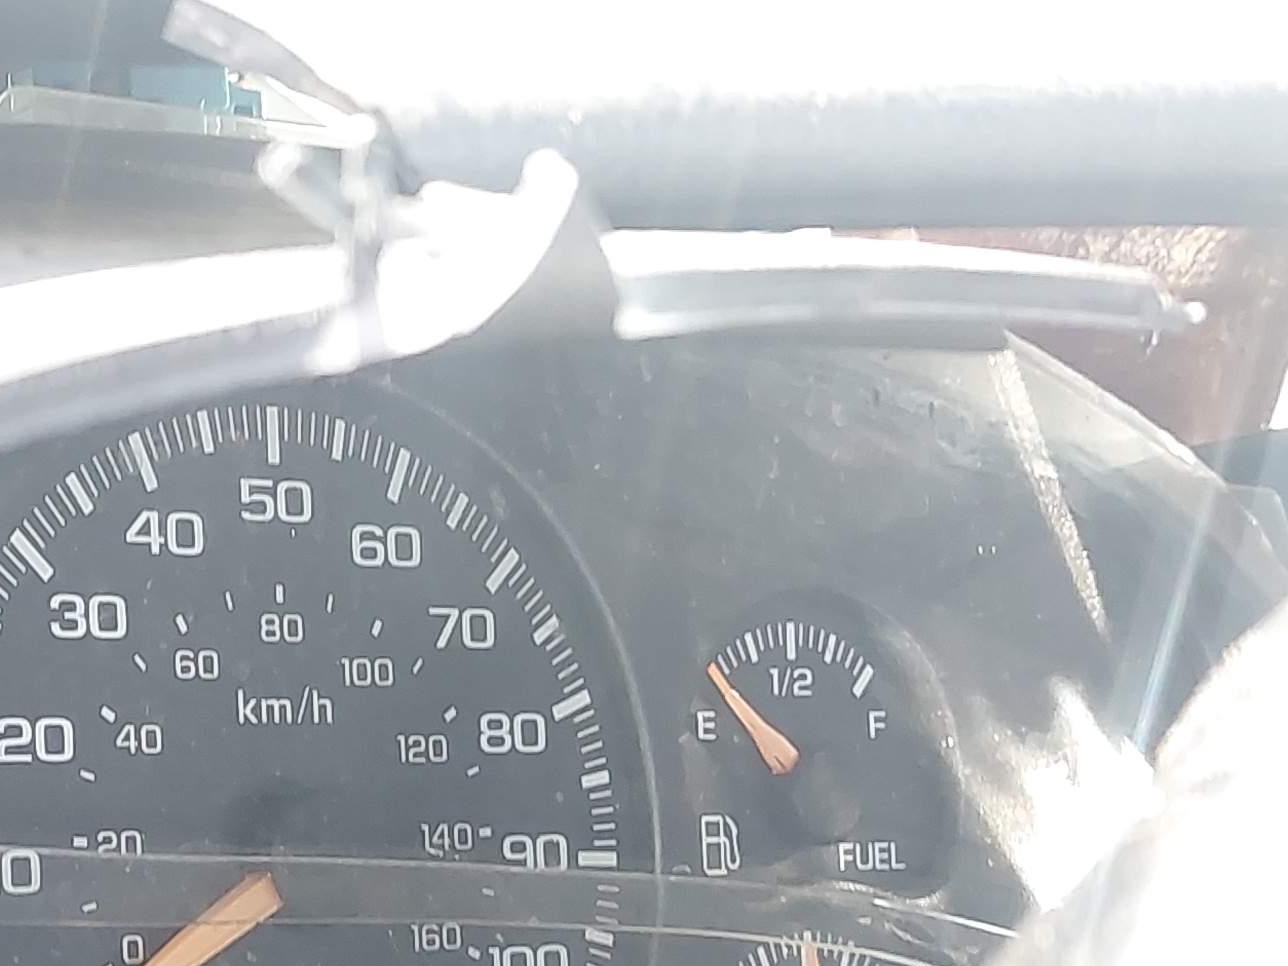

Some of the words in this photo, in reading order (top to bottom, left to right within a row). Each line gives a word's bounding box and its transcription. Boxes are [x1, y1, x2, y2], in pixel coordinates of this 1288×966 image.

[240, 479, 312, 522] 50
[126, 511, 204, 555] 40
[352, 525, 422, 567] 60
[49, 594, 128, 639] 30
[260, 614, 304, 642] 80
[428, 607, 495, 649] 70
[174, 650, 220, 680] 60
[341, 656, 394, 687] 100
[769, 666, 813, 697] 1/2
[236, 685, 334, 725] km/h
[115, 724, 163, 754] 40
[479, 713, 547, 754] 80
[697, 711, 717, 741] E
[867, 711, 887, 739] F
[397, 734, 448, 763] 120
[97, 831, 143, 857] 20
[421, 822, 472, 852] 140
[502, 833, 568, 871] 90
[838, 842, 906, 872] FUEL
[121, 935, 144, 965] 0
[412, 923, 462, 952] 160
